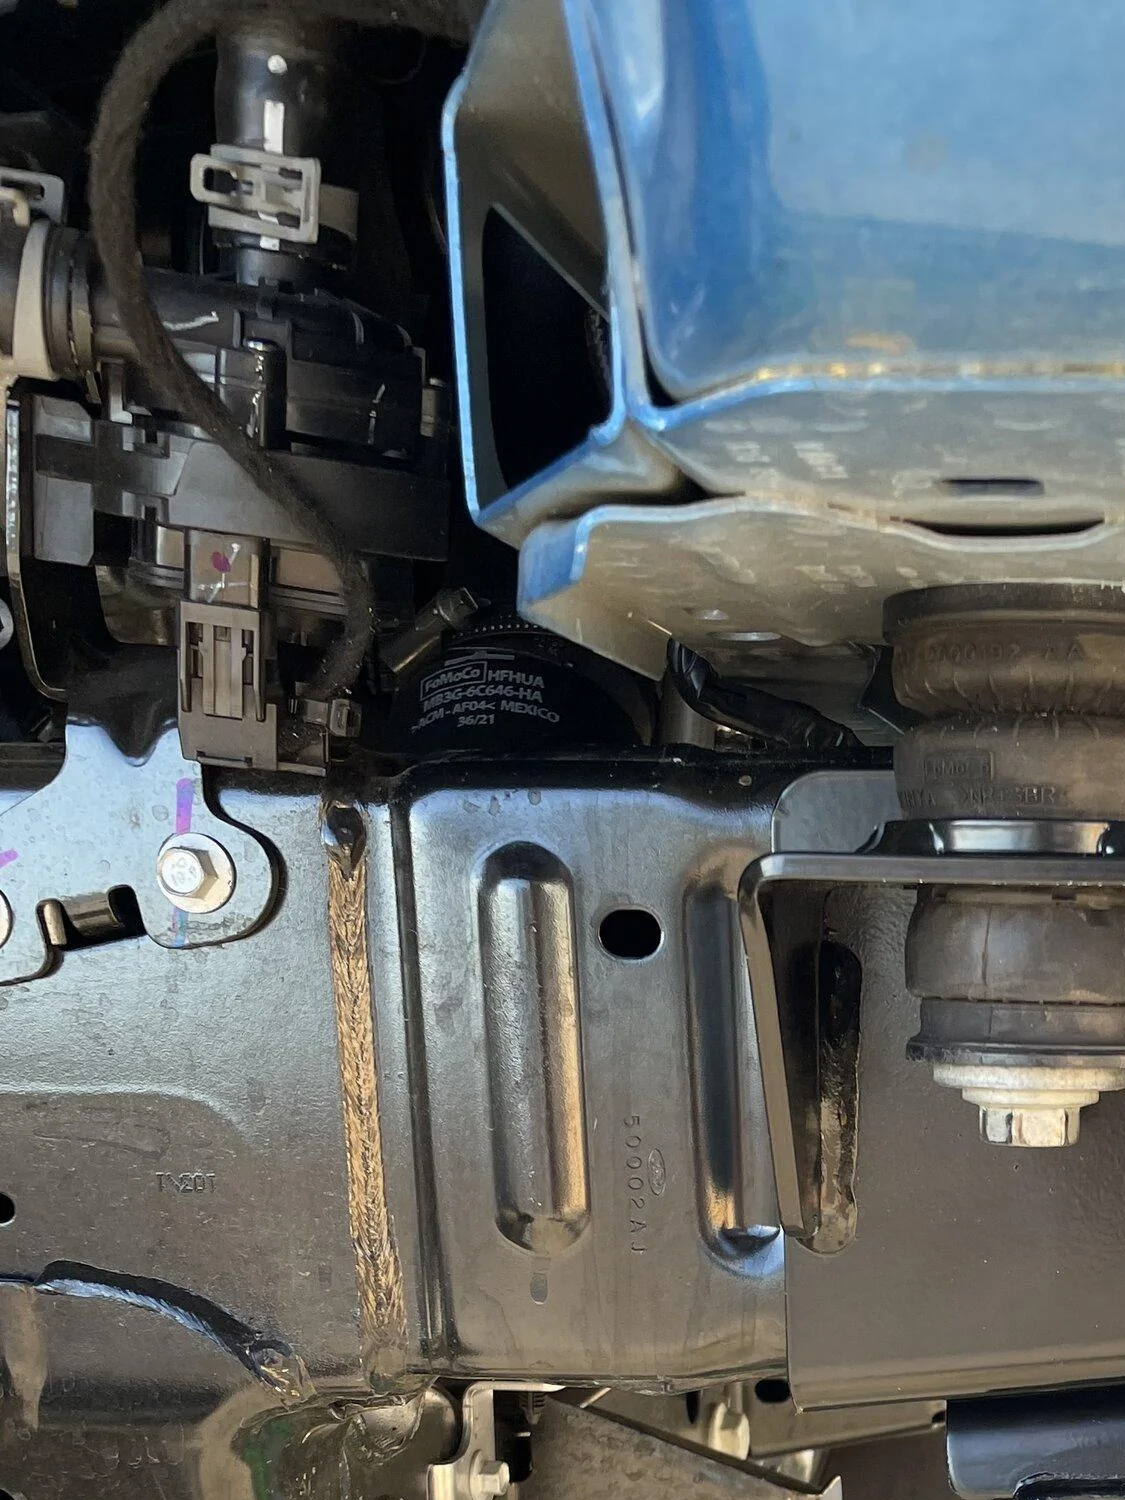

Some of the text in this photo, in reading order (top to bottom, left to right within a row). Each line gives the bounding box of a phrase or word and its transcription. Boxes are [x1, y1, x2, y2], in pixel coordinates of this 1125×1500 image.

[424, 666, 545, 693] FoMoCo HFHUA
[457, 713, 495, 728] 36/21
[500, 699, 560, 724] MEXICO
[623, 1115, 648, 1252] 50002AJ
